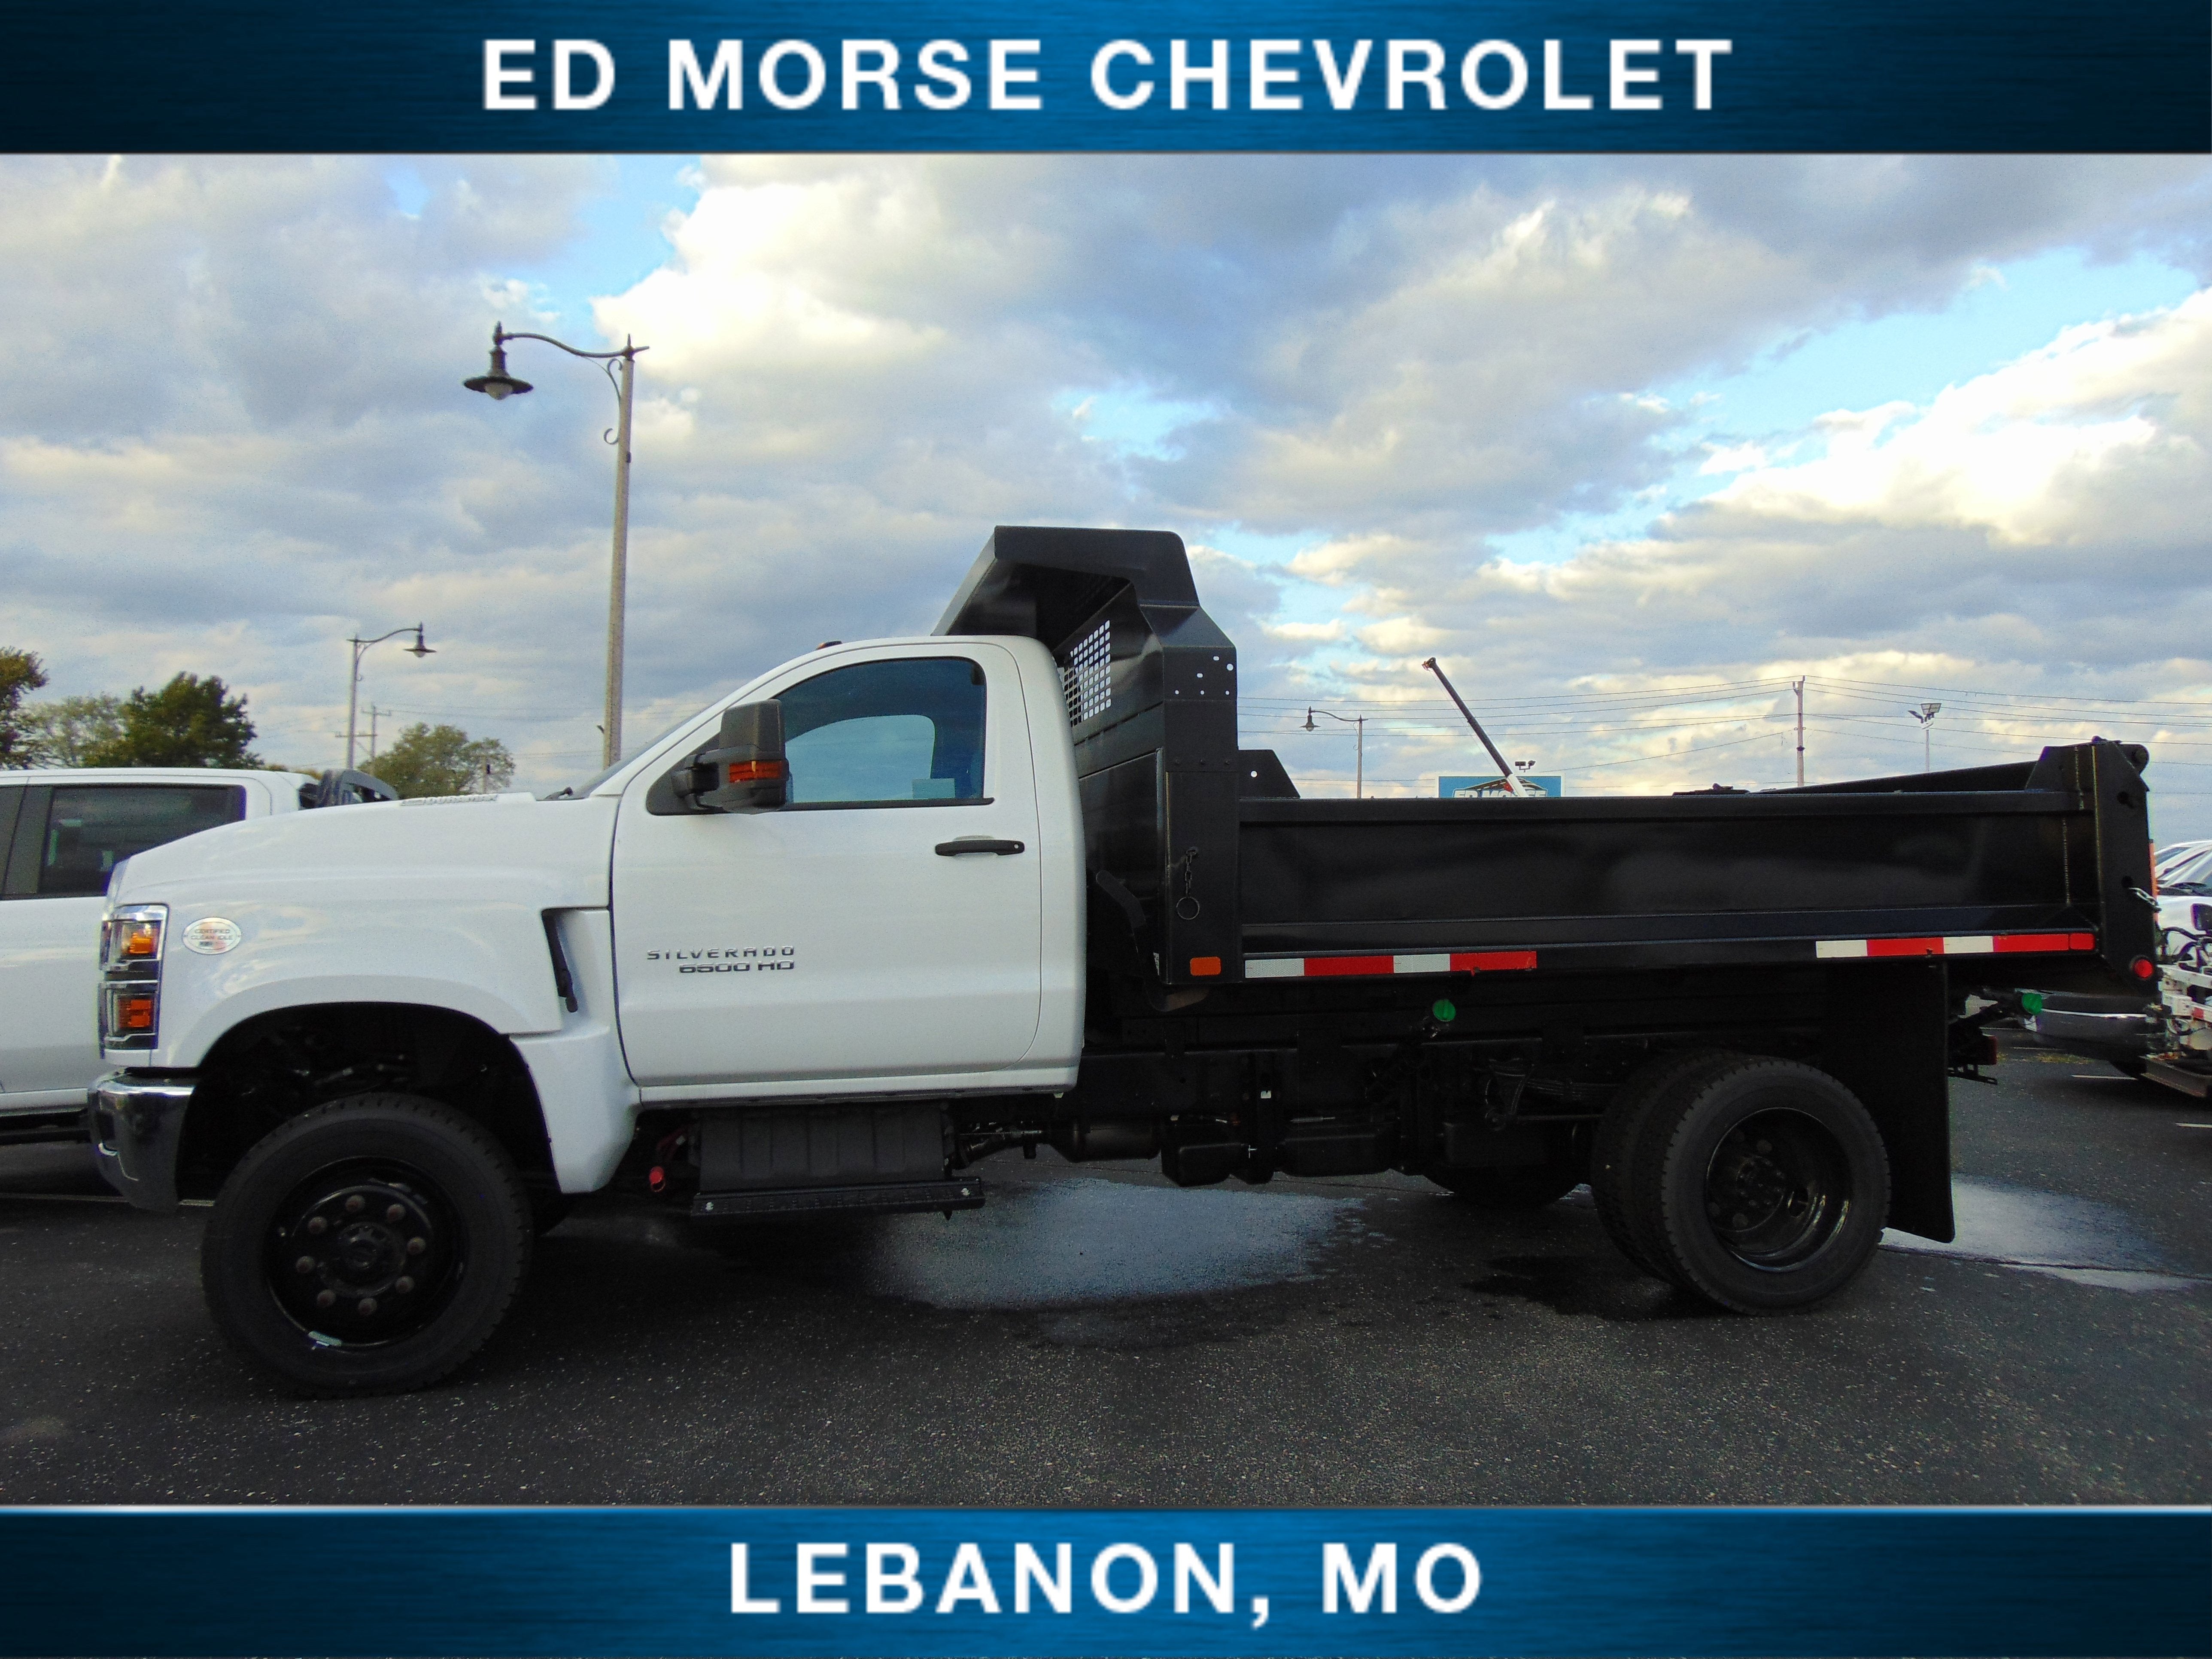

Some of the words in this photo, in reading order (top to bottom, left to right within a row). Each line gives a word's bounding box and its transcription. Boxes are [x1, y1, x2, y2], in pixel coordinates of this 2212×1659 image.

[647, 945, 794, 960] SILVERADO
[679, 961, 750, 973] 6500
[758, 959, 794, 970] HD
